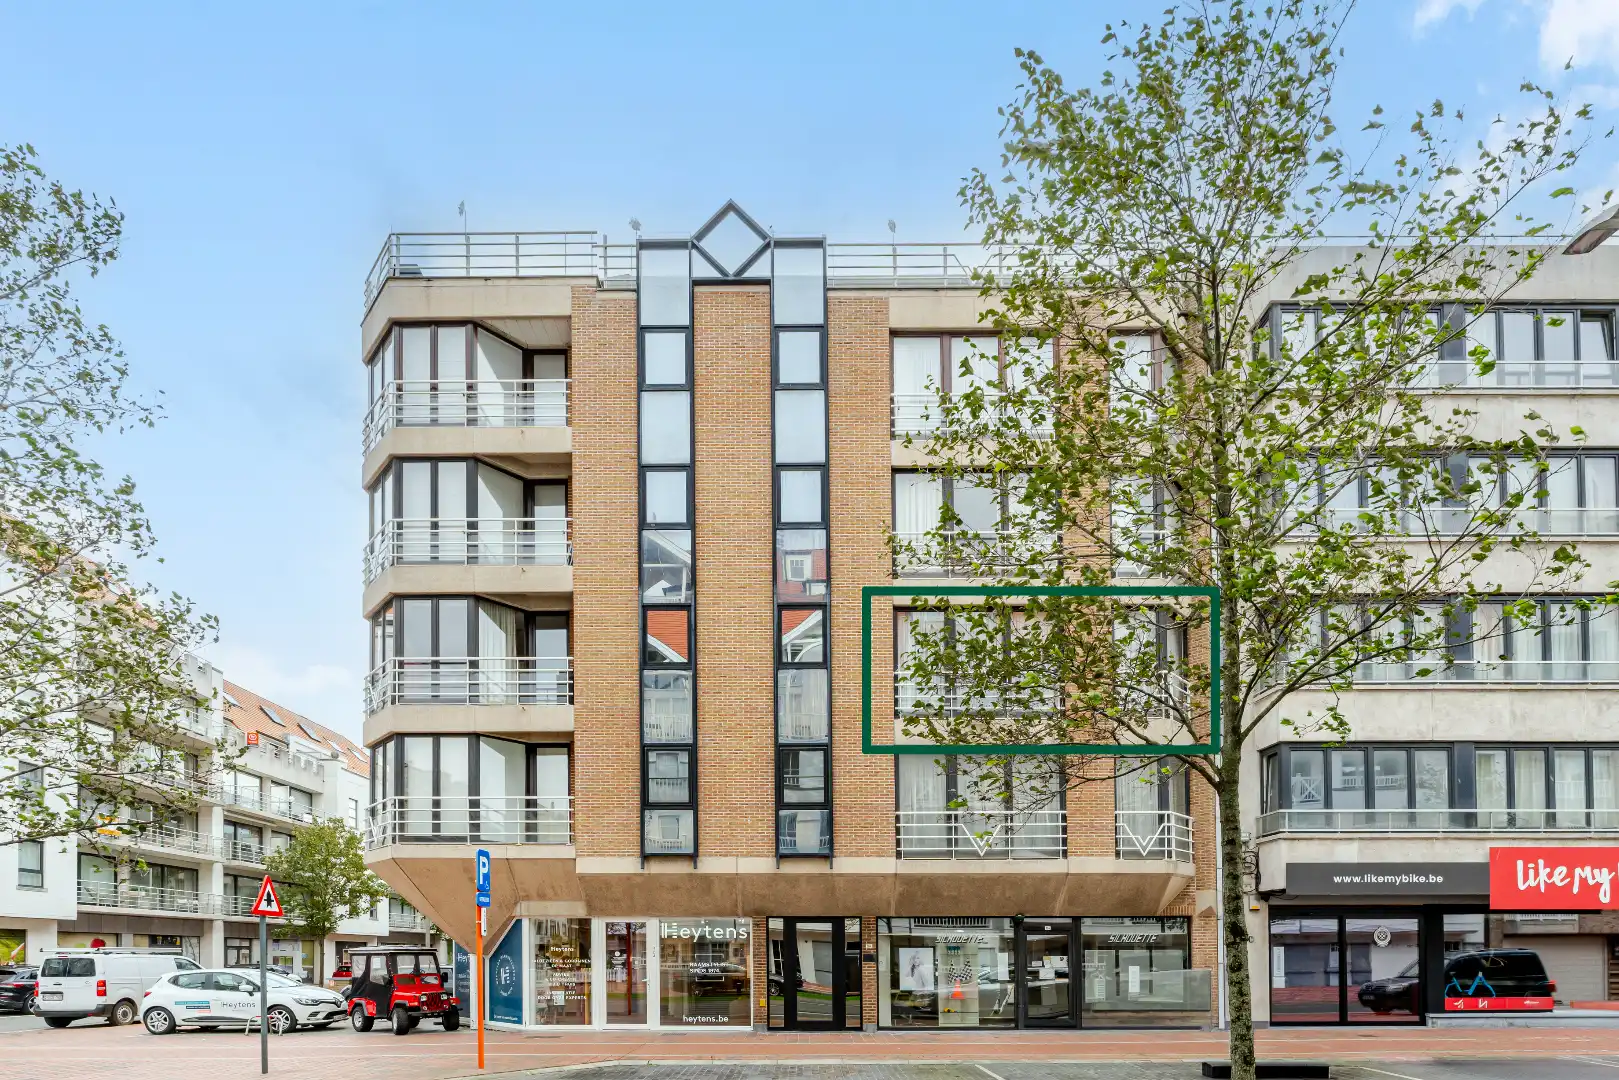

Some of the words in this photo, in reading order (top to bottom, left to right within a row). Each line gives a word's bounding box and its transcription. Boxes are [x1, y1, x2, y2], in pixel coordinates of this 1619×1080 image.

[479, 855, 489, 885] P
[1333, 873, 1444, 886] www.likemybike.be
[661, 922, 748, 943] Heytens
[935, 934, 984, 943] SILHOUETTE
[1107, 933, 1158, 943] SILHOUETTE
[221, 1001, 256, 1009] Heytens
[682, 1014, 729, 1024] heytens.be
